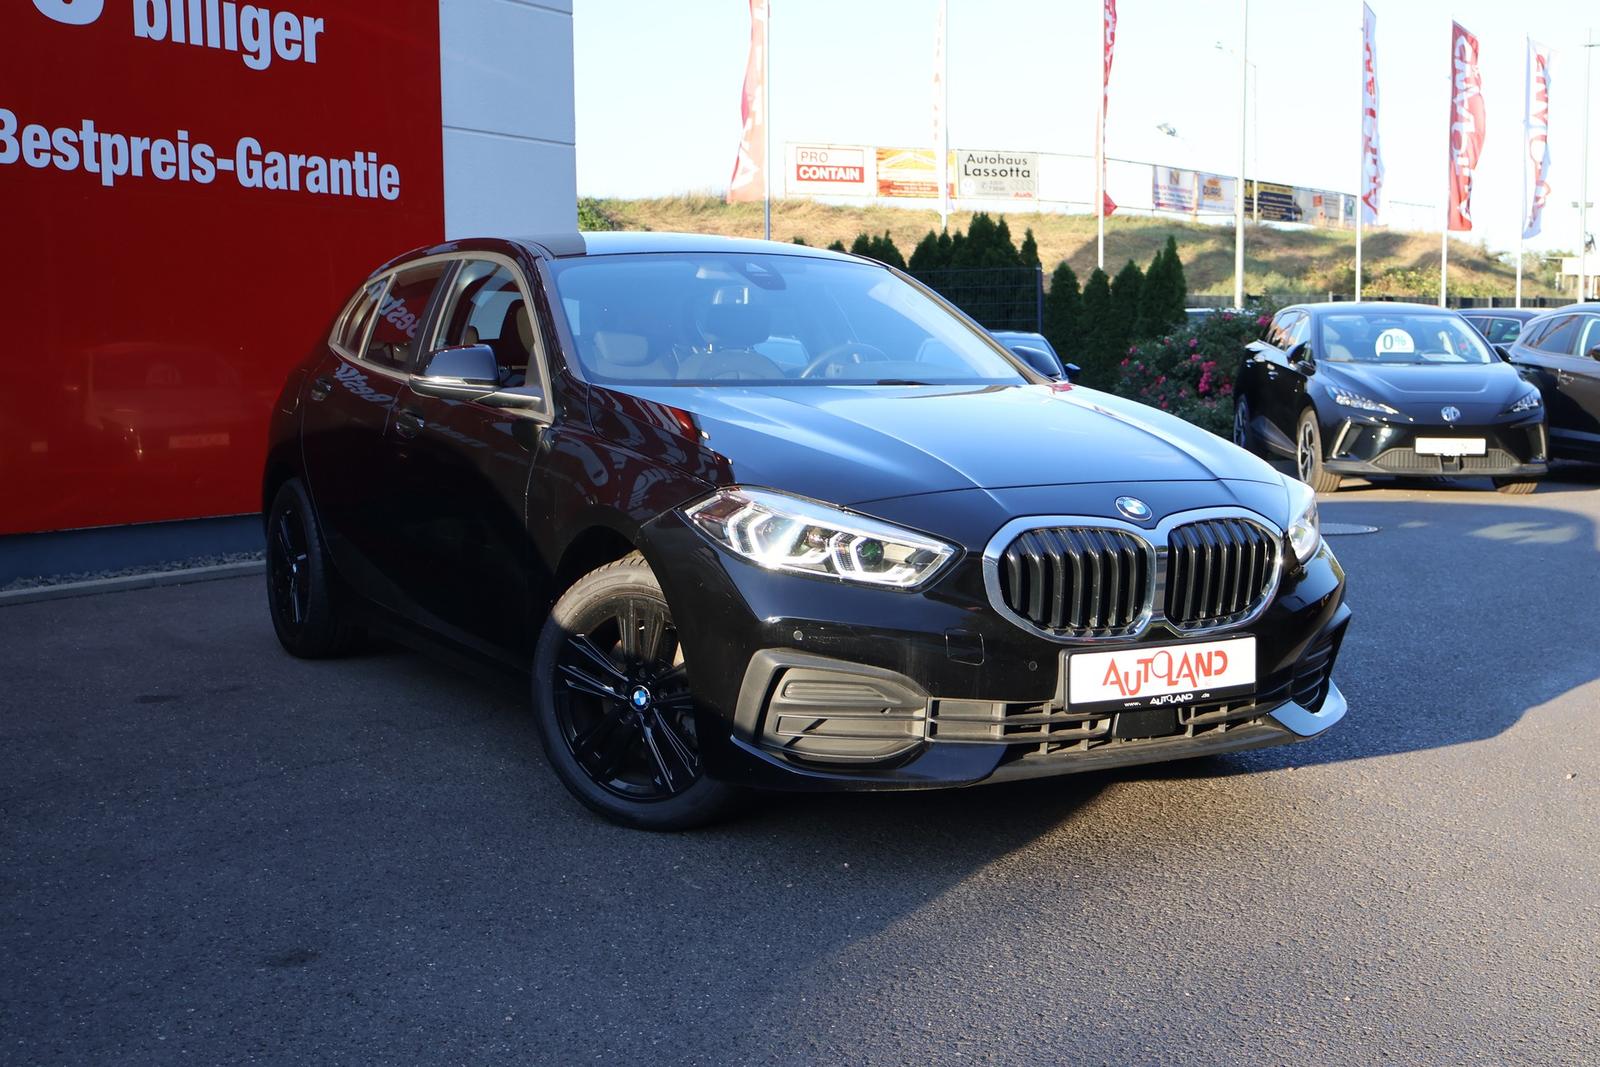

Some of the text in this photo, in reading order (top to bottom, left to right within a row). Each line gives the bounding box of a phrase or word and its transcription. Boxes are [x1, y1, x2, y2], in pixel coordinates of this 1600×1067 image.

[132, 0, 324, 70] billiger
[0, 108, 400, 200] Bestpreis-Garantie
[801, 151, 829, 163] PRO
[966, 153, 1028, 166] Autohaus
[799, 165, 860, 181] CONTAIN
[964, 164, 1031, 178] Lassotta
